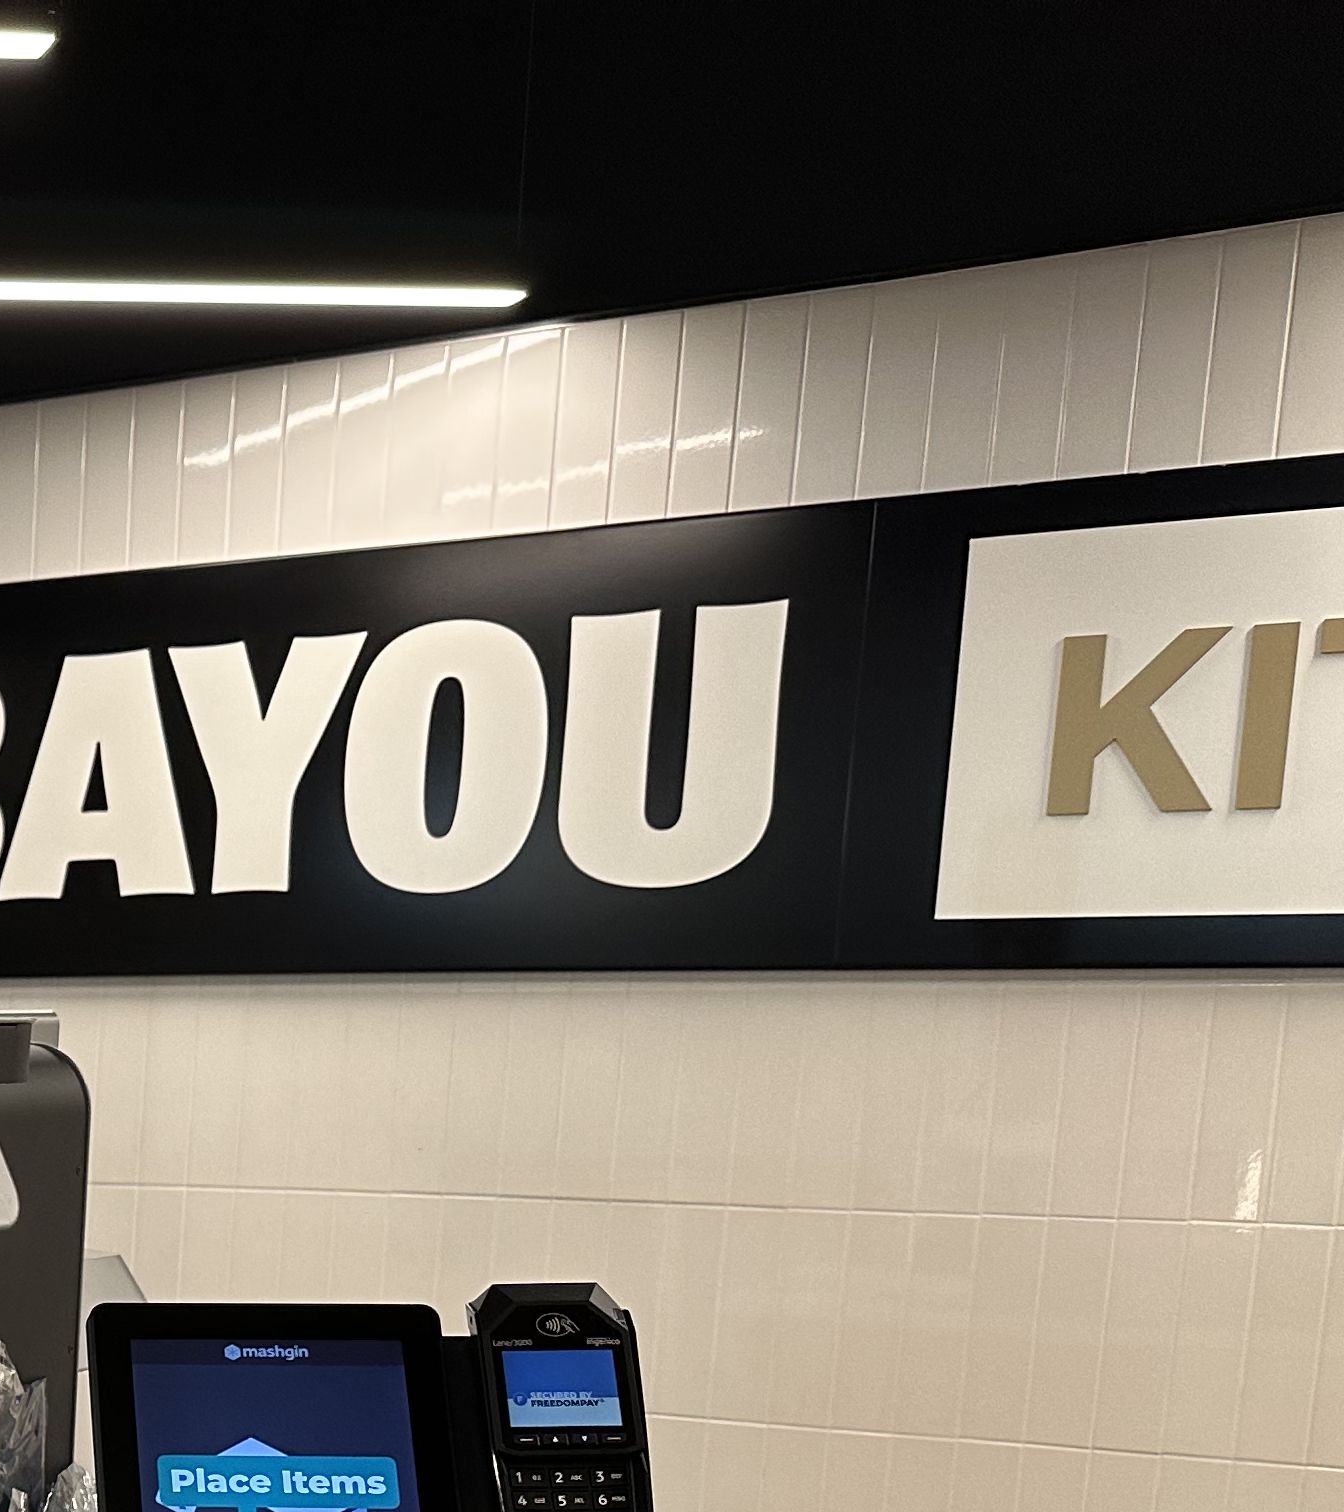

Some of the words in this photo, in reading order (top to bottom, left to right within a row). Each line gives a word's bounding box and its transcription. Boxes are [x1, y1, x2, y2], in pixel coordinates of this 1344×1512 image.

[242, 1344, 309, 1361] mashgin
[170, 1467, 272, 1494] Place
[281, 1469, 387, 1495] Items
[516, 1471, 523, 1483] 1
[554, 1471, 564, 1483] 2
[595, 1470, 605, 1483] 3
[517, 1495, 528, 1506] 4
[557, 1495, 567, 1507] 5
[598, 1494, 608, 1506] 6
